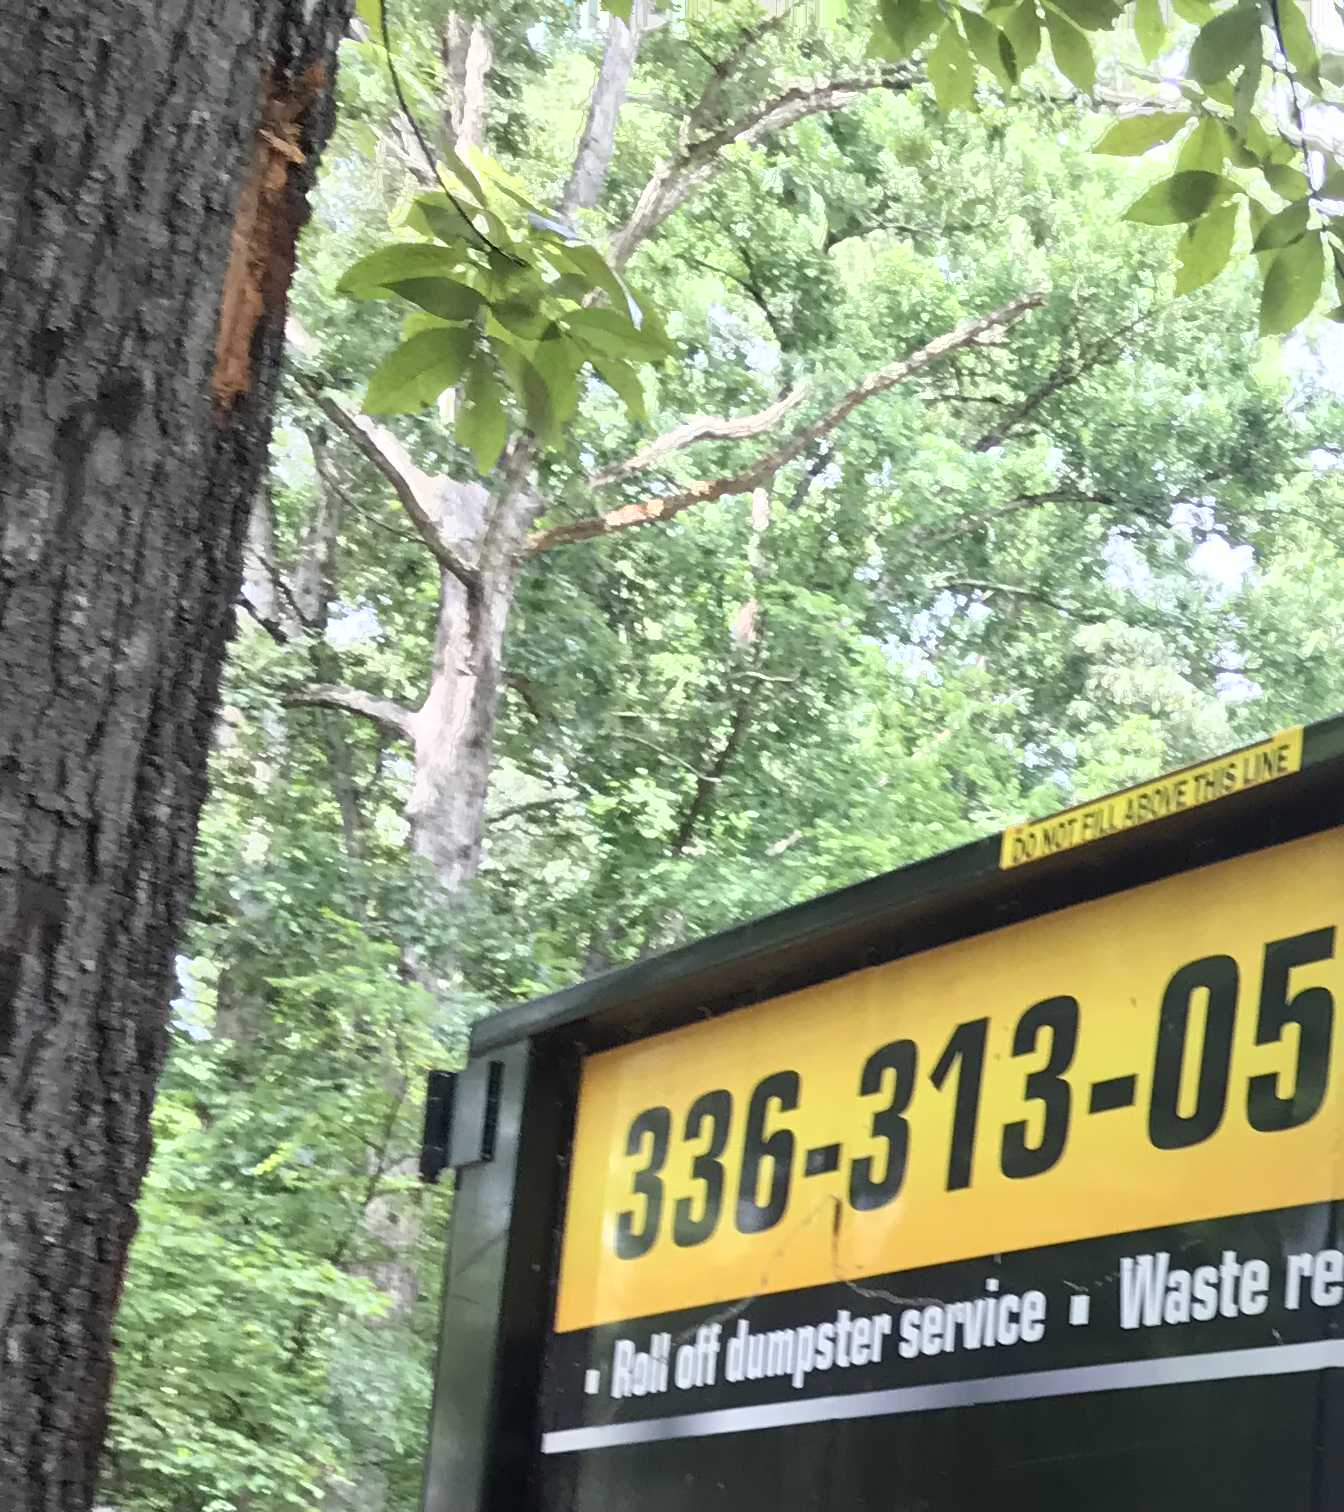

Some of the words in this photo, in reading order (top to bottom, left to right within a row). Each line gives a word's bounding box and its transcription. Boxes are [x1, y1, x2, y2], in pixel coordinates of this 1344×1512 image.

[1193, 762, 1238, 807] THIS
[1242, 744, 1290, 786] LINE
[611, 1332, 671, 1399] Roll
[675, 1322, 722, 1390] off
[725, 1309, 892, 1388] dumpster
[899, 1278, 1047, 1359] service
[1119, 1250, 1270, 1330] Waste
